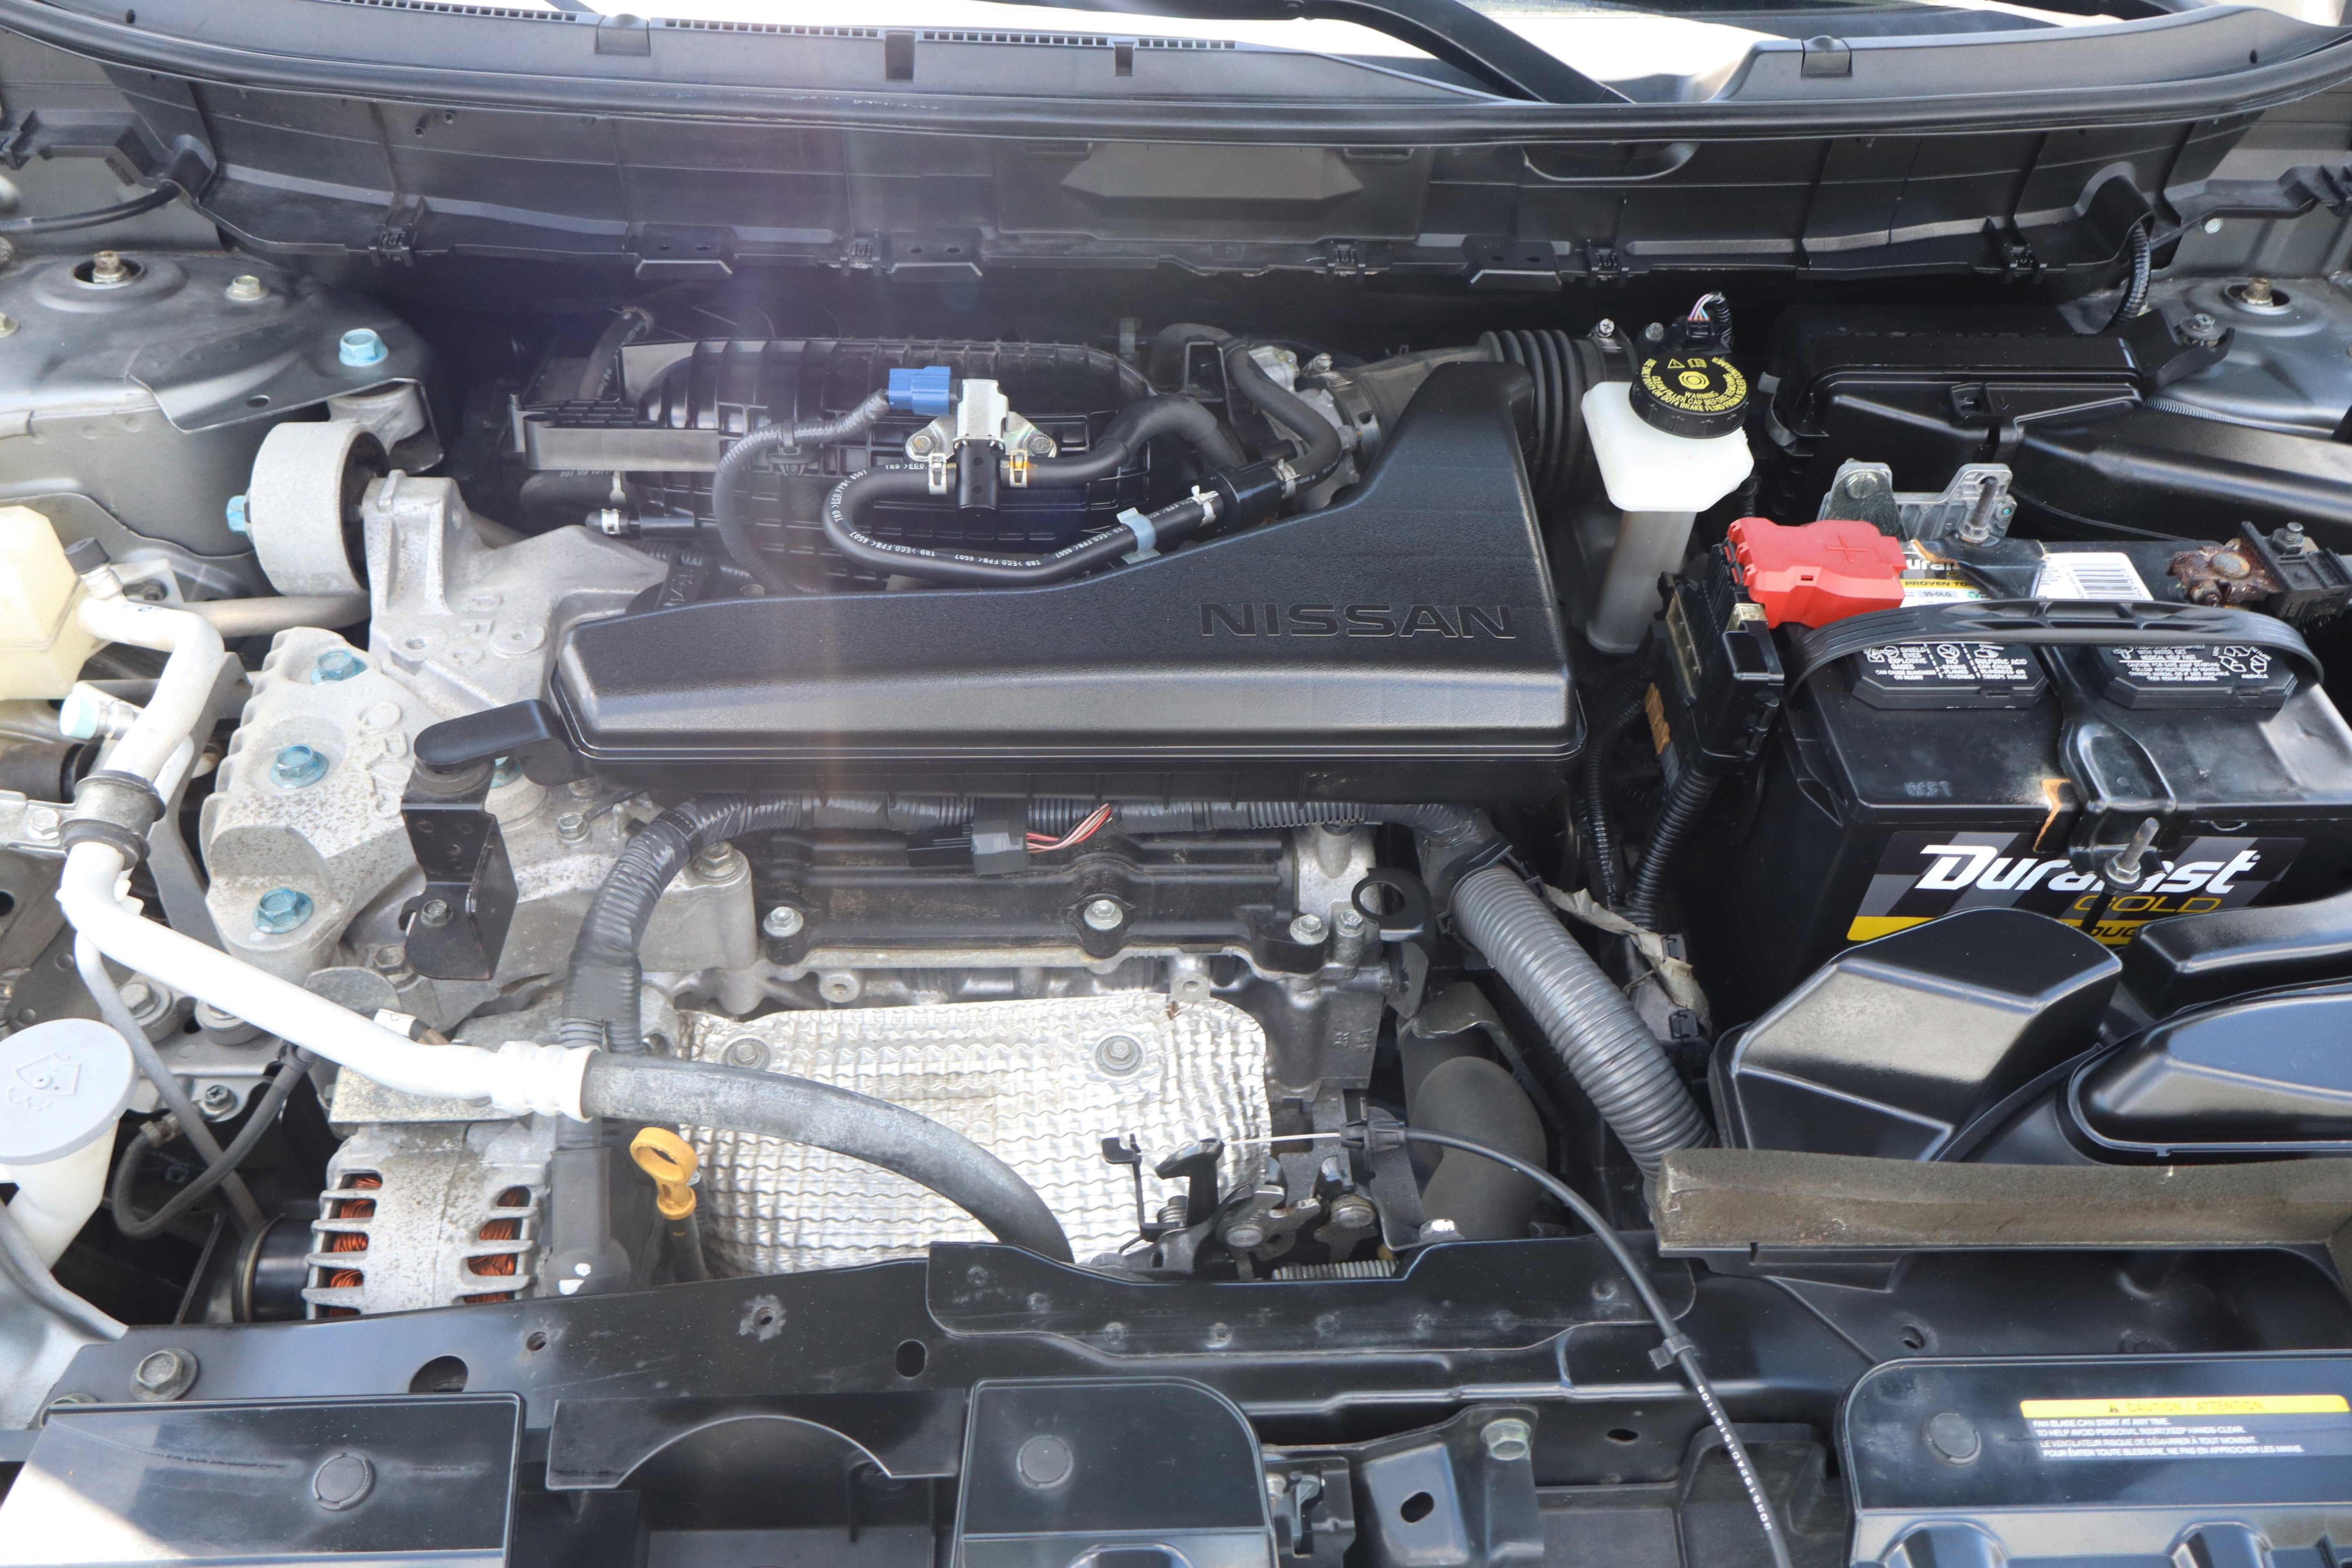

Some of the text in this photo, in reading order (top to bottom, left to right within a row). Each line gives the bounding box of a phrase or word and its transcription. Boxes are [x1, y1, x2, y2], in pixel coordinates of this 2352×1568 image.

[1652, 376, 1668, 391] CLEAN
[1663, 389, 1686, 402] FILLER
[1679, 402, 1704, 411] BRAKE
[832, 510, 843, 522] TRD
[850, 470, 867, 480] 6507
[849, 532, 869, 544] 6507
[1055, 548, 1073, 558] 6507
[1199, 603, 1516, 639] NISSAN
[2127, 1402, 2182, 1412] CAUTION
[2198, 1401, 2263, 1411] ATTENTION
[2146, 1437, 2192, 1446] DÉMARRER
[2067, 1448, 2095, 1457] ÉVITER
[2209, 1446, 2261, 1454] APPROCHER
